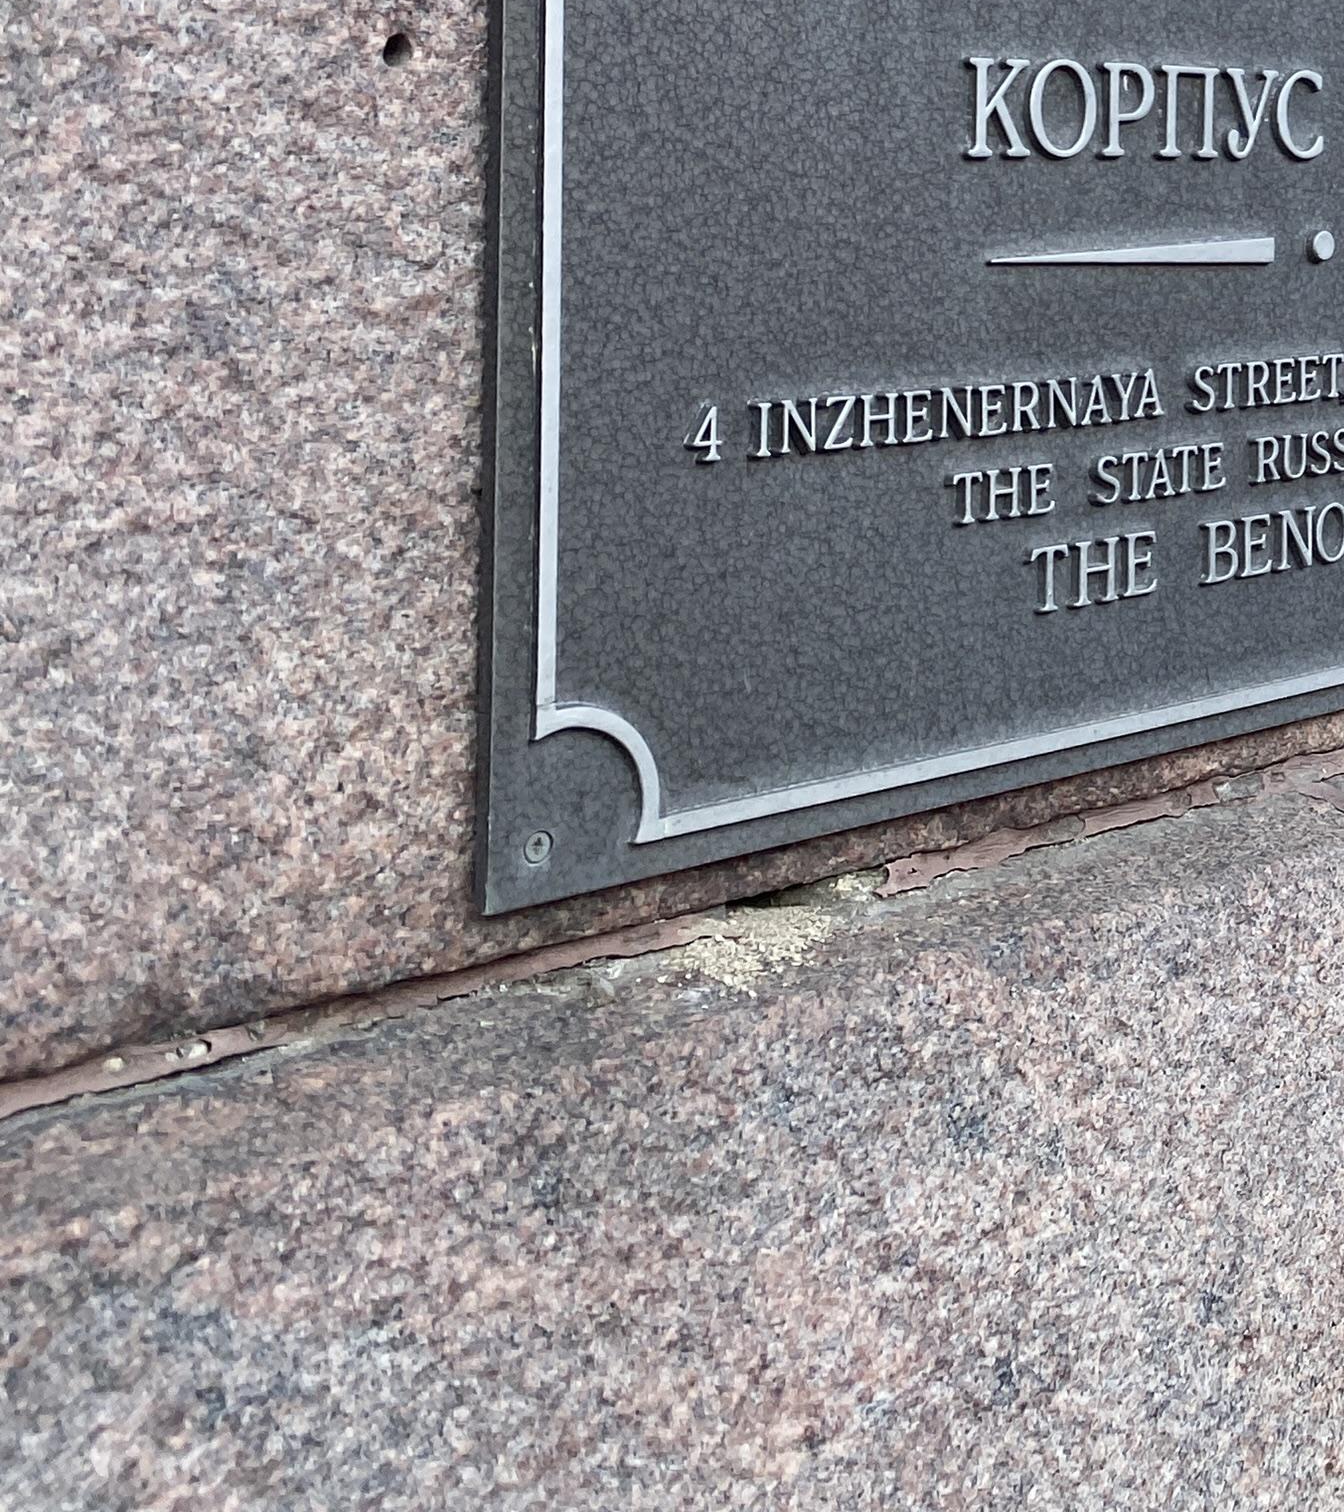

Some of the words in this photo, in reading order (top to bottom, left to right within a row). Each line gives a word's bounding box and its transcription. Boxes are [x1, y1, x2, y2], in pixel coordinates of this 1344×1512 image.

[965, 56, 1324, 161] КОРПУС
[686, 402, 722, 463] 4
[748, 368, 1165, 459] INZHENERNAYA
[949, 463, 1056, 526] THE
[1091, 441, 1227, 506] STATE
[1028, 530, 1158, 614] THE
